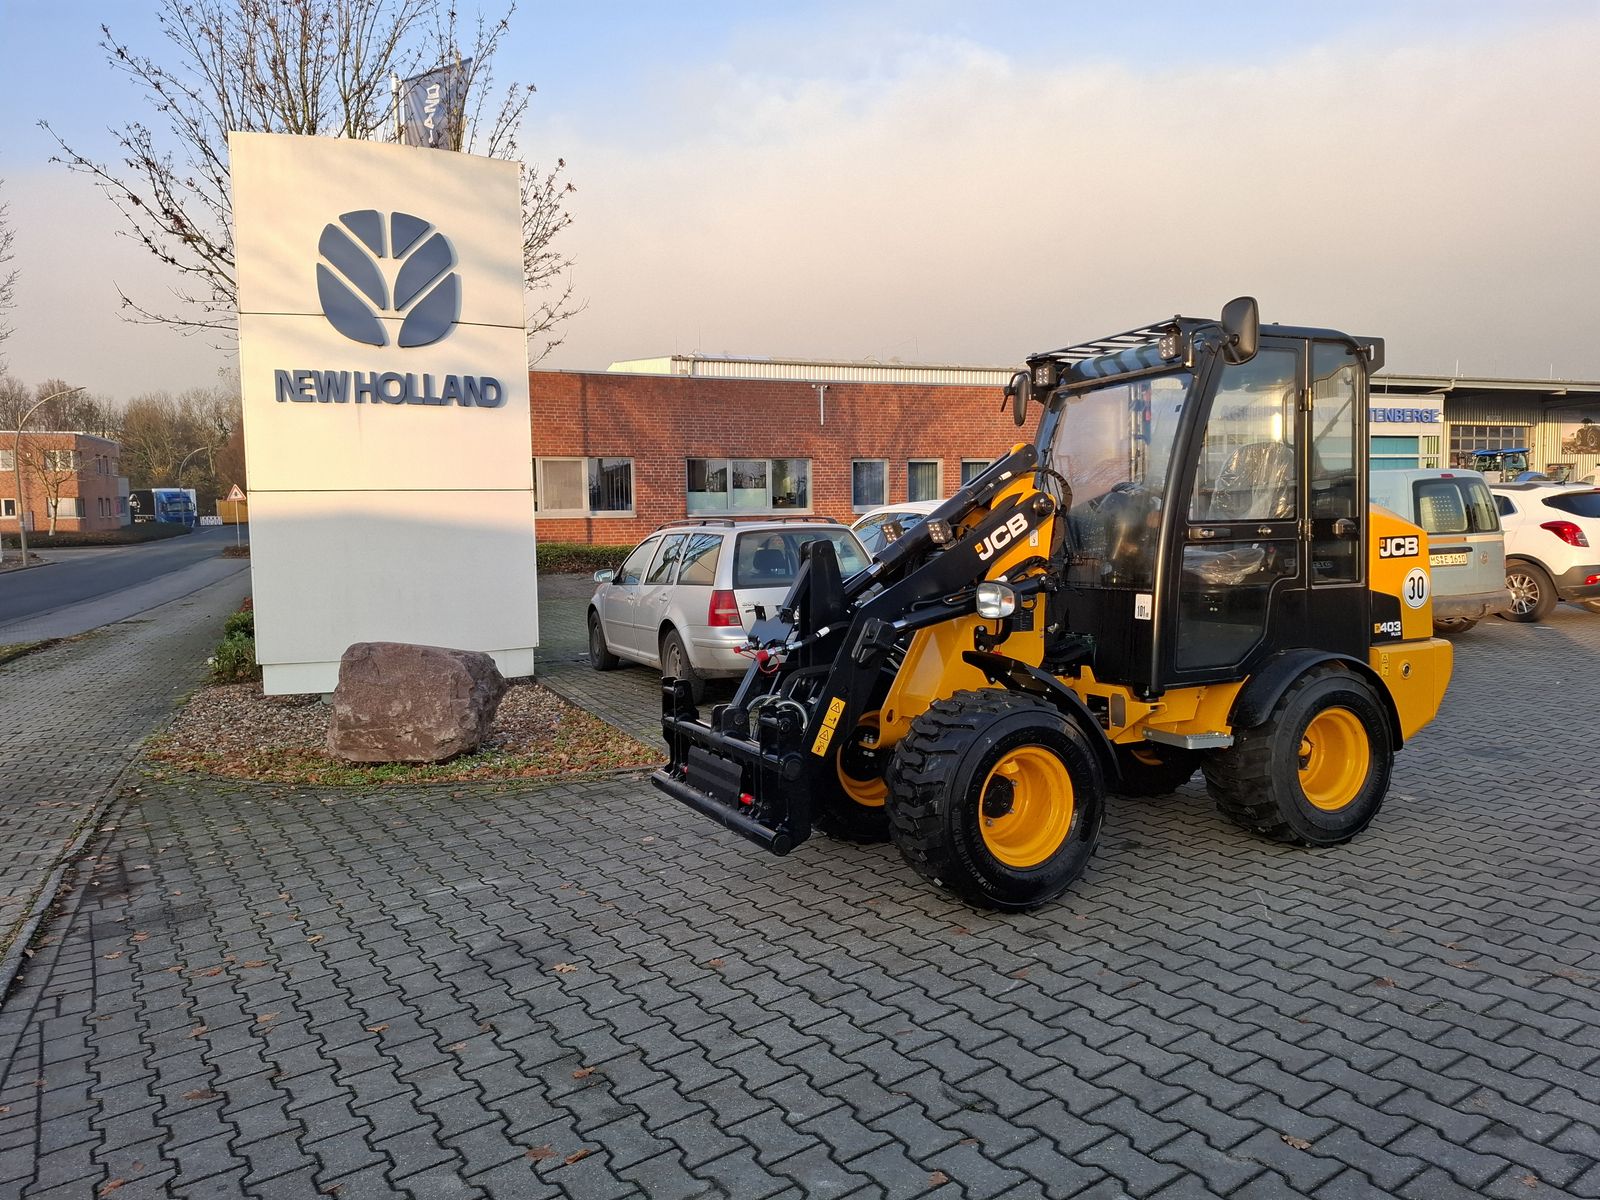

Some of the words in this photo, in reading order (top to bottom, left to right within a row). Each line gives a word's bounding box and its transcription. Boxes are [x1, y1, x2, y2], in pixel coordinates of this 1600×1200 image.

[274, 369, 347, 403] NEW
[354, 371, 502, 408] HOLLAND
[976, 512, 1029, 561] JCB
[1380, 537, 1419, 557] JCB
[1408, 576, 1425, 600] 30
[1380, 620, 1402, 633] 403
